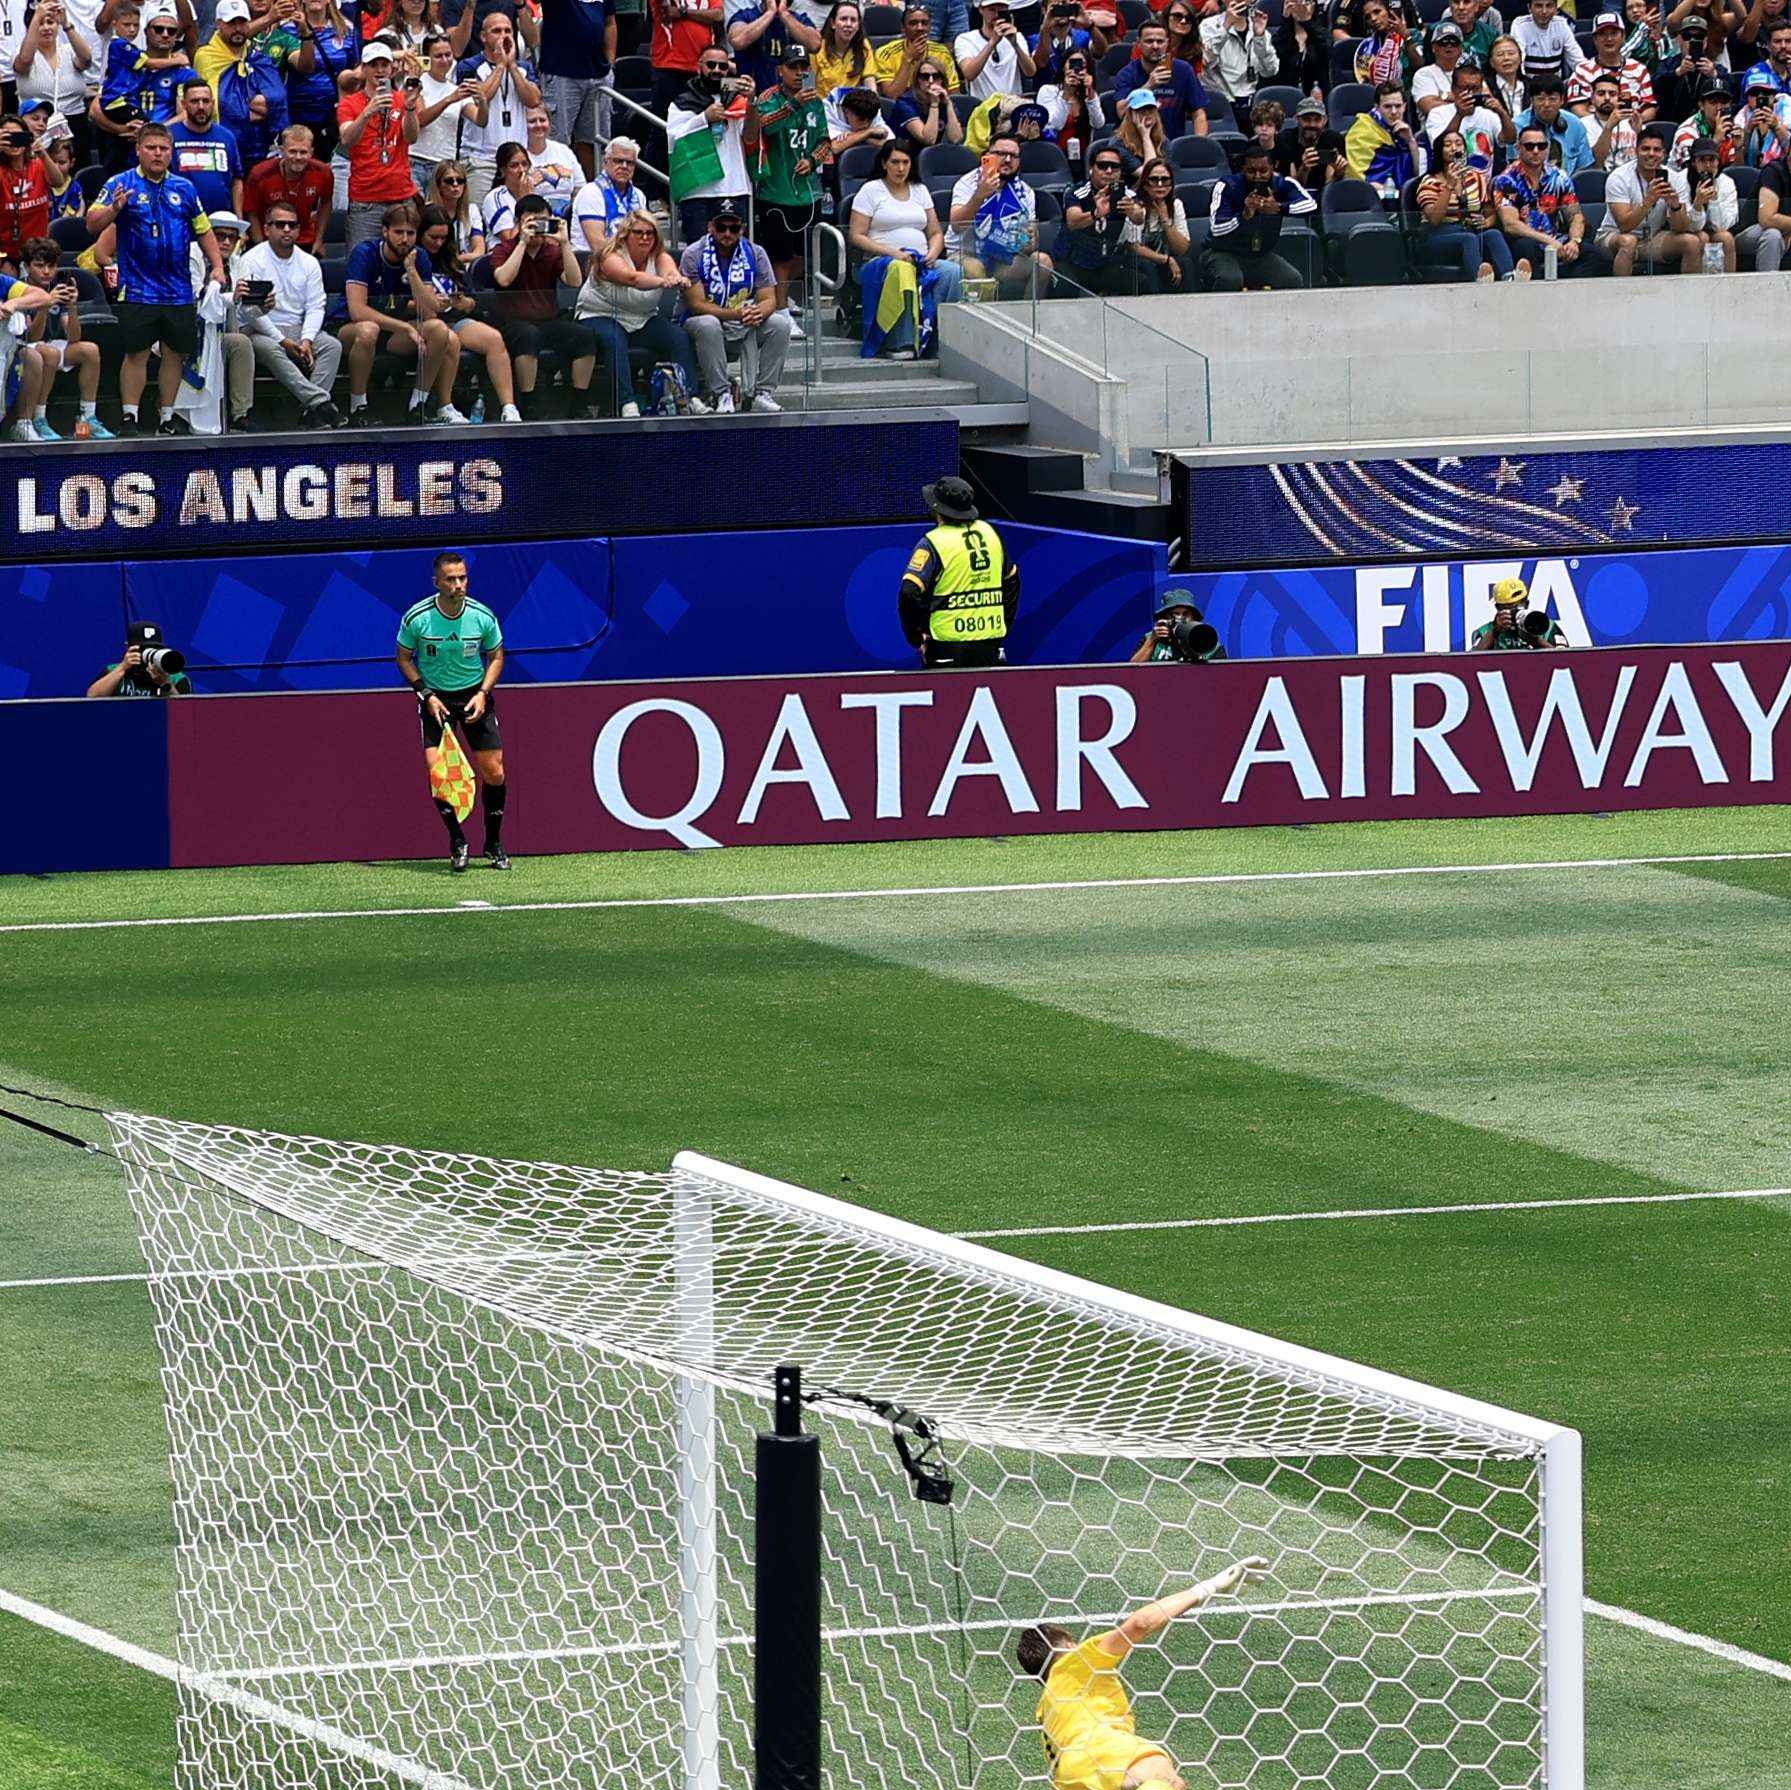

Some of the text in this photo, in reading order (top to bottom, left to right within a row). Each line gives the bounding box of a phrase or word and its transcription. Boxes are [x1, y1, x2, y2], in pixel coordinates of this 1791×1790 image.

[17, 459, 503, 534] LOS ANGELES
[1355, 559, 1594, 656] FIFA
[593, 684, 1150, 849] QATAR
